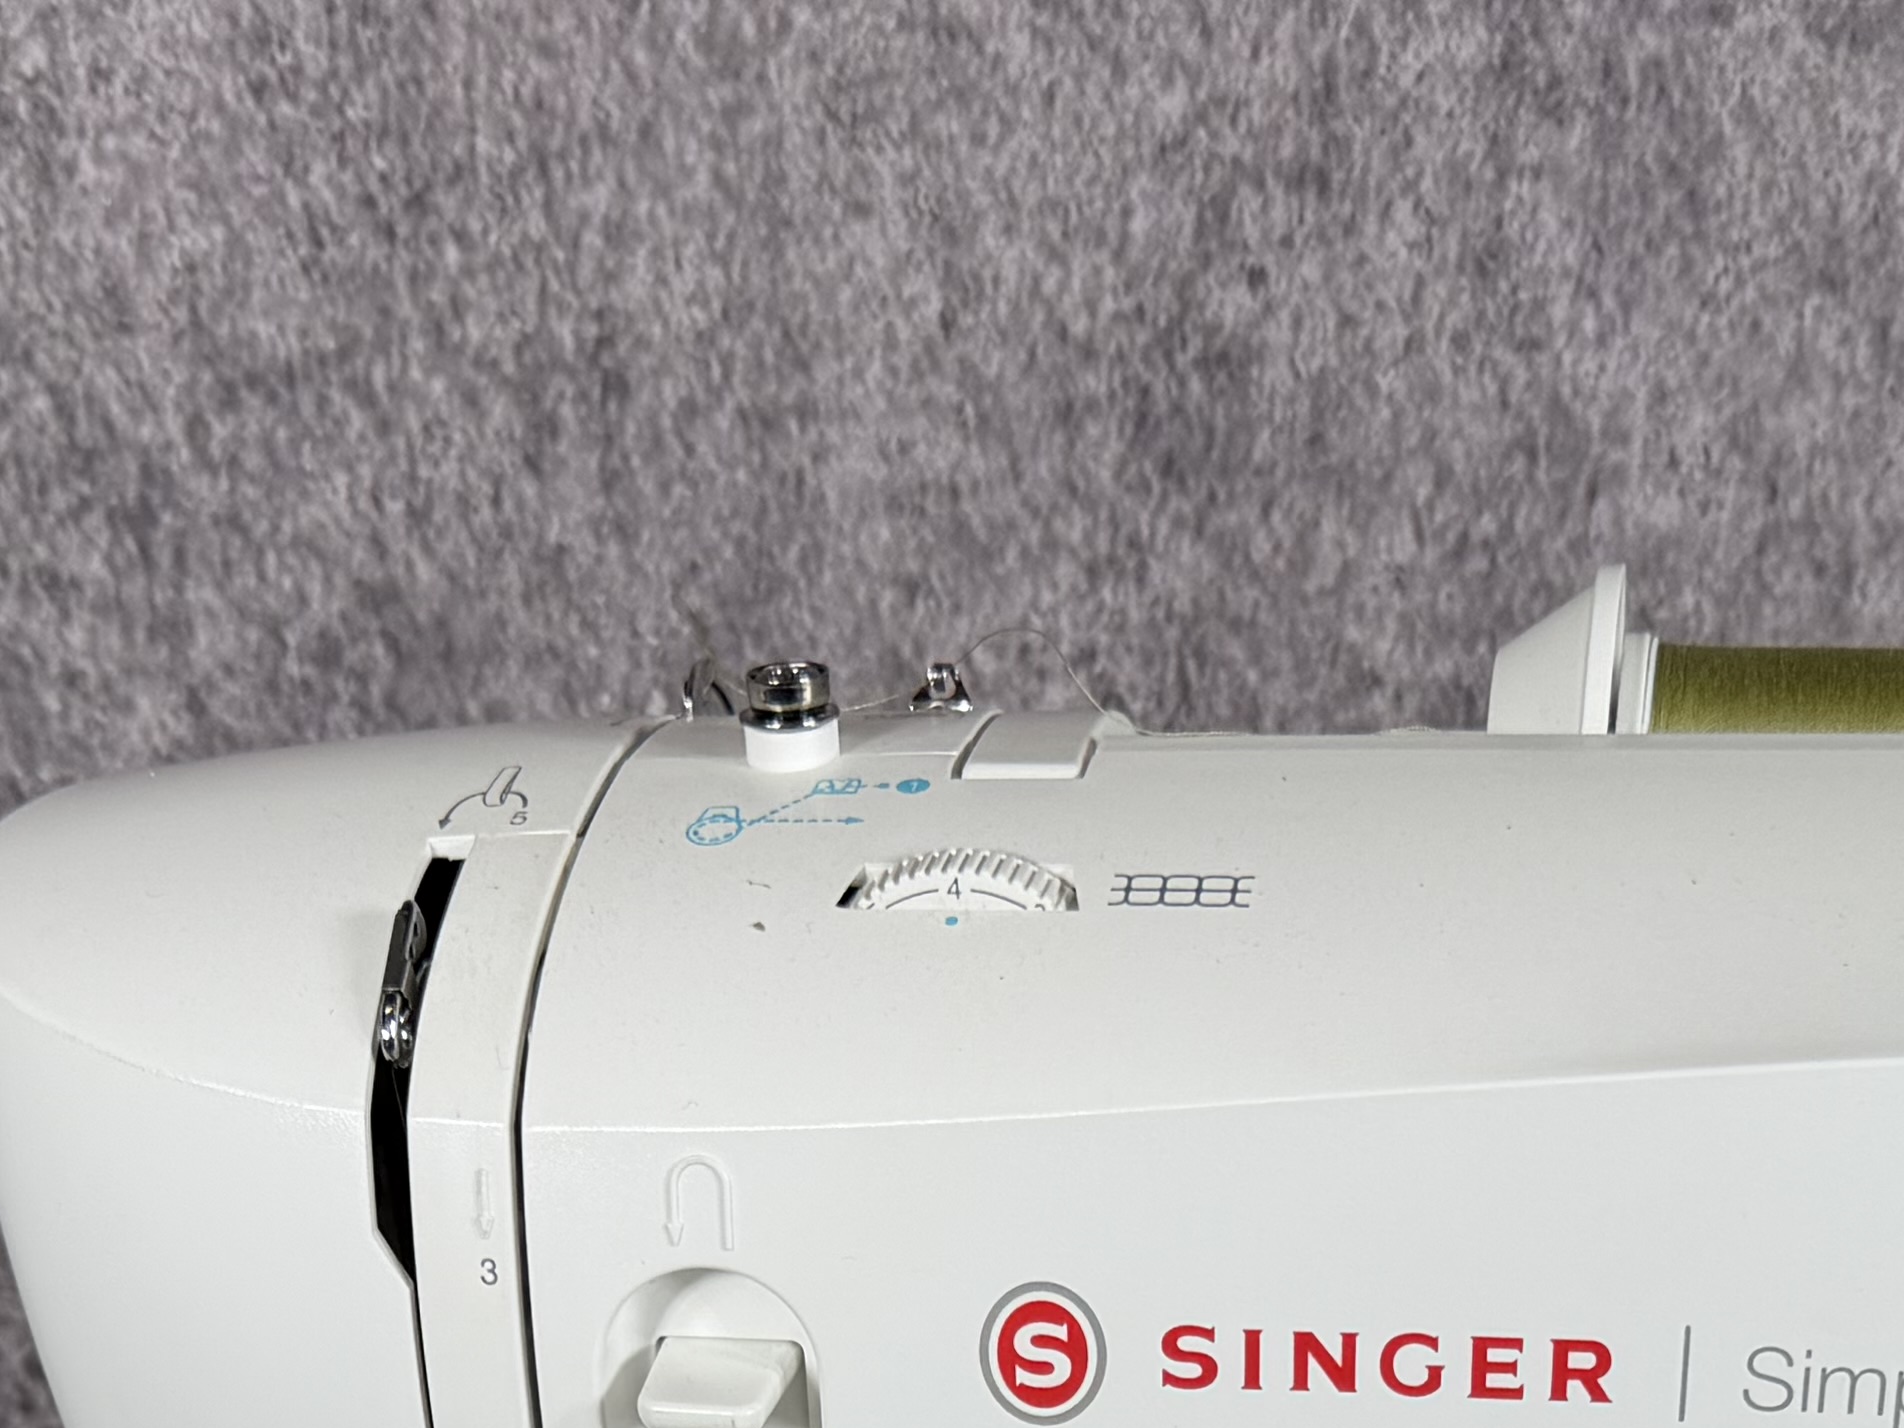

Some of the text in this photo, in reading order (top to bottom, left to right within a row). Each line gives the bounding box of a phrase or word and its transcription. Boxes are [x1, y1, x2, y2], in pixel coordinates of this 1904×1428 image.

[509, 811, 528, 826] 5
[947, 877, 962, 900] 4
[480, 1257, 499, 1286] 3
[1160, 1323, 1613, 1404] SINGER
